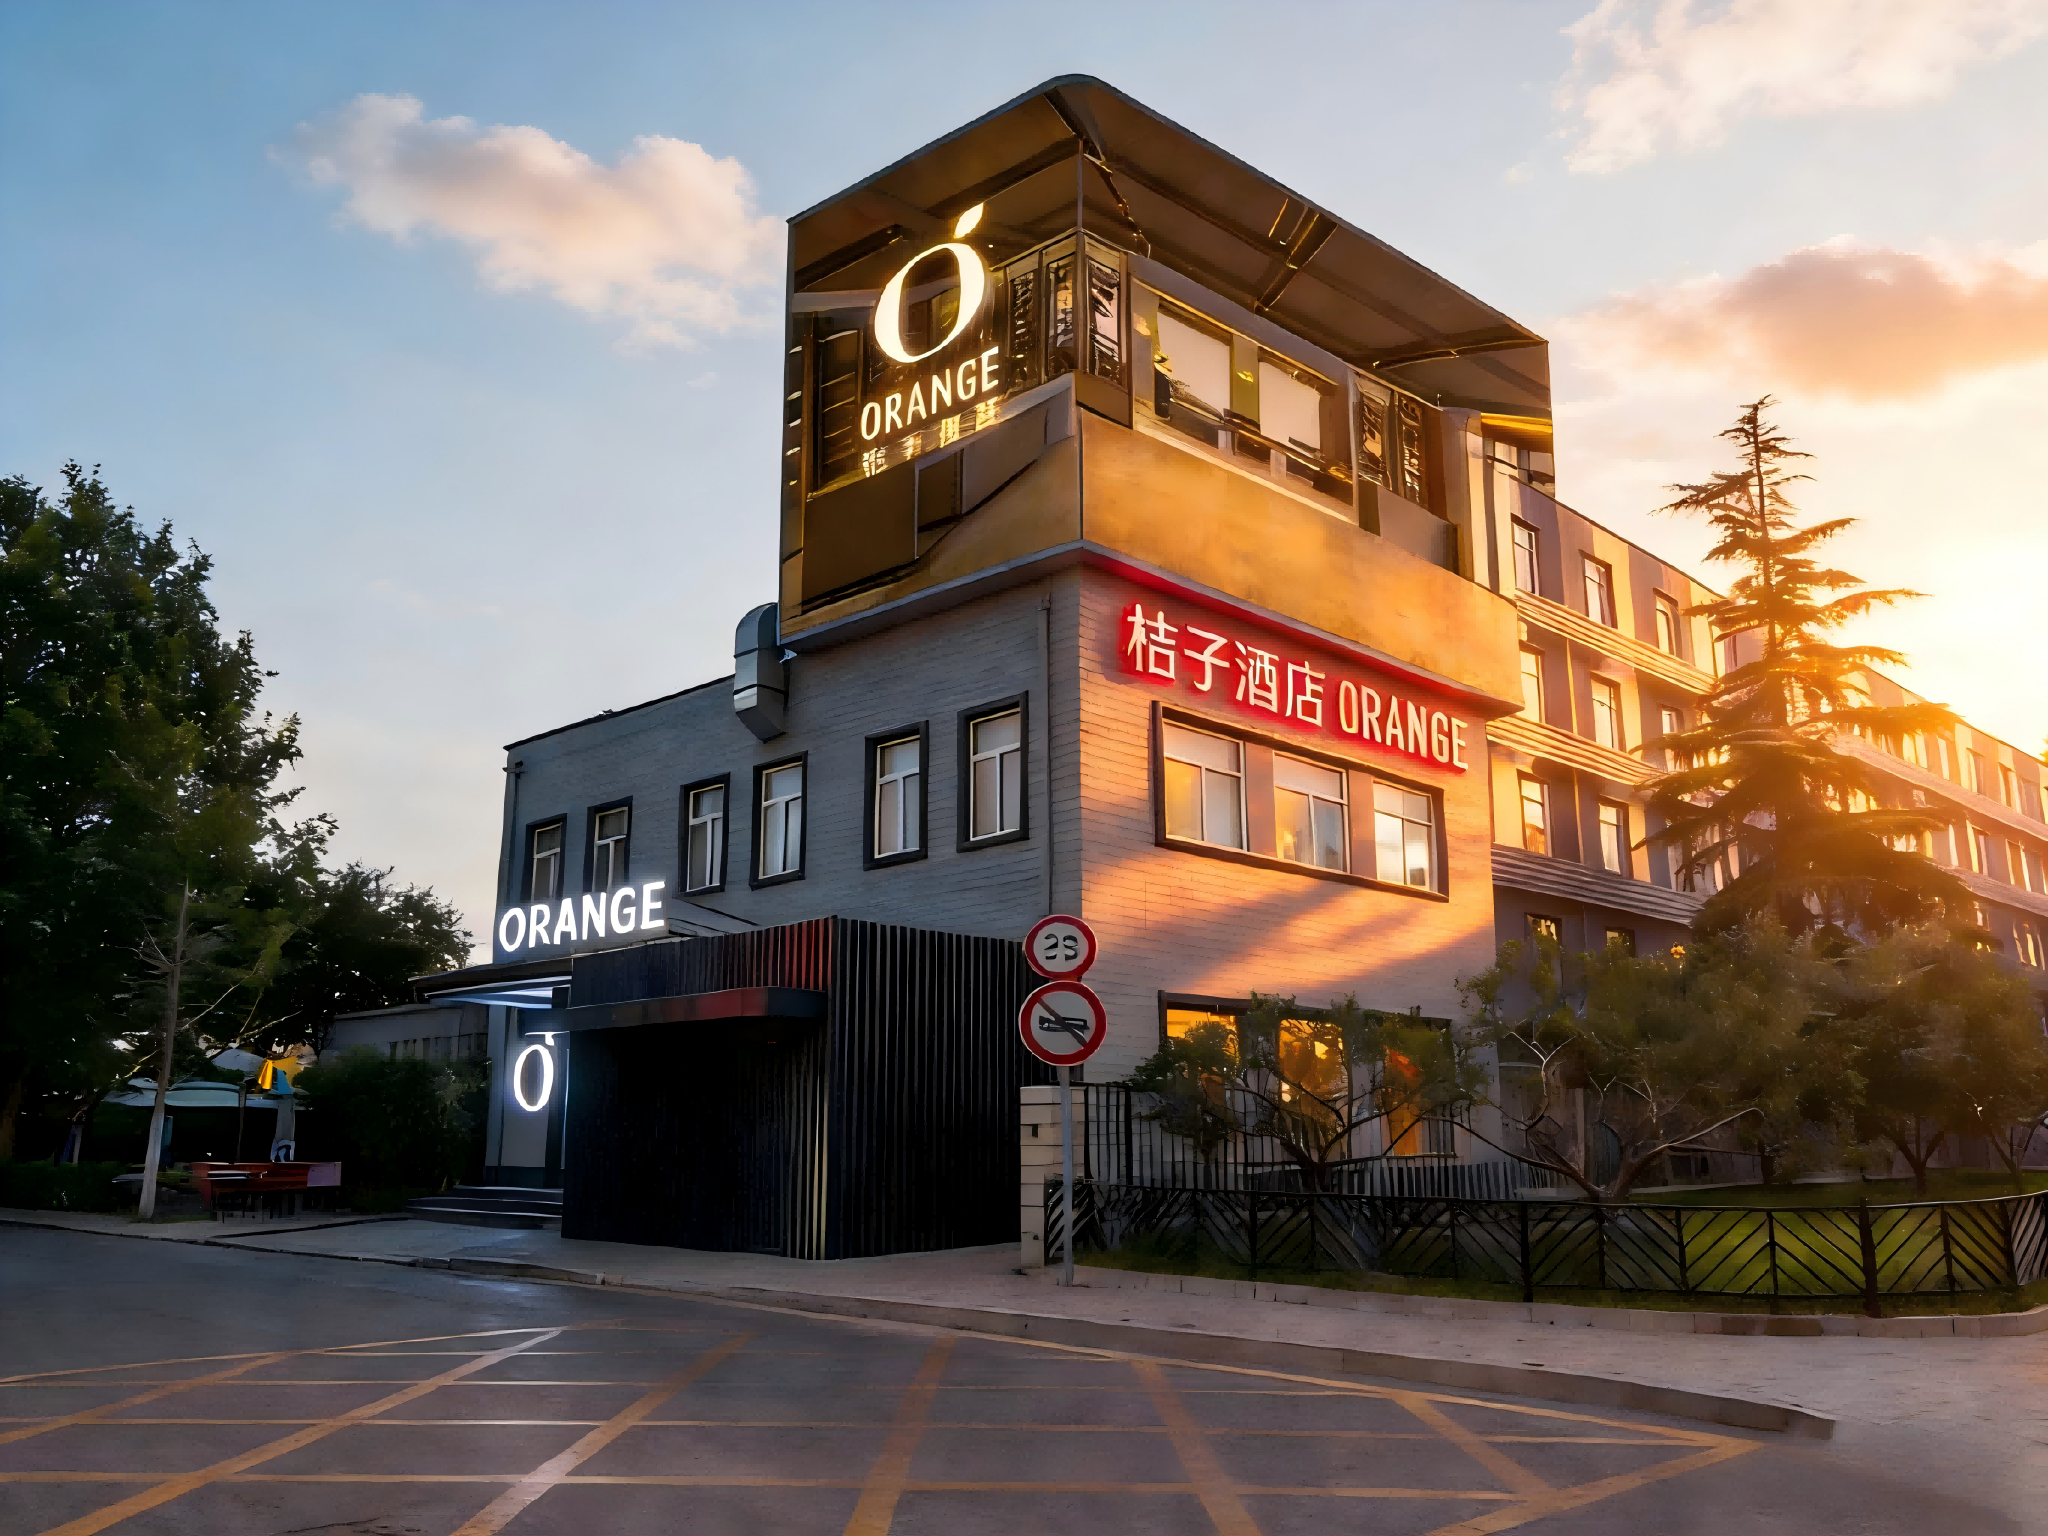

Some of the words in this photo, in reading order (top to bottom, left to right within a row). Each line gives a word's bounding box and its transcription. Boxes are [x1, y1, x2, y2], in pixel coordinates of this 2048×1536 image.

[860, 346, 999, 440] ORANGE
[1126, 603, 1326, 728] 桔子酒店
[1339, 680, 1469, 771] ORANGE
[499, 880, 666, 952] ORANGE
